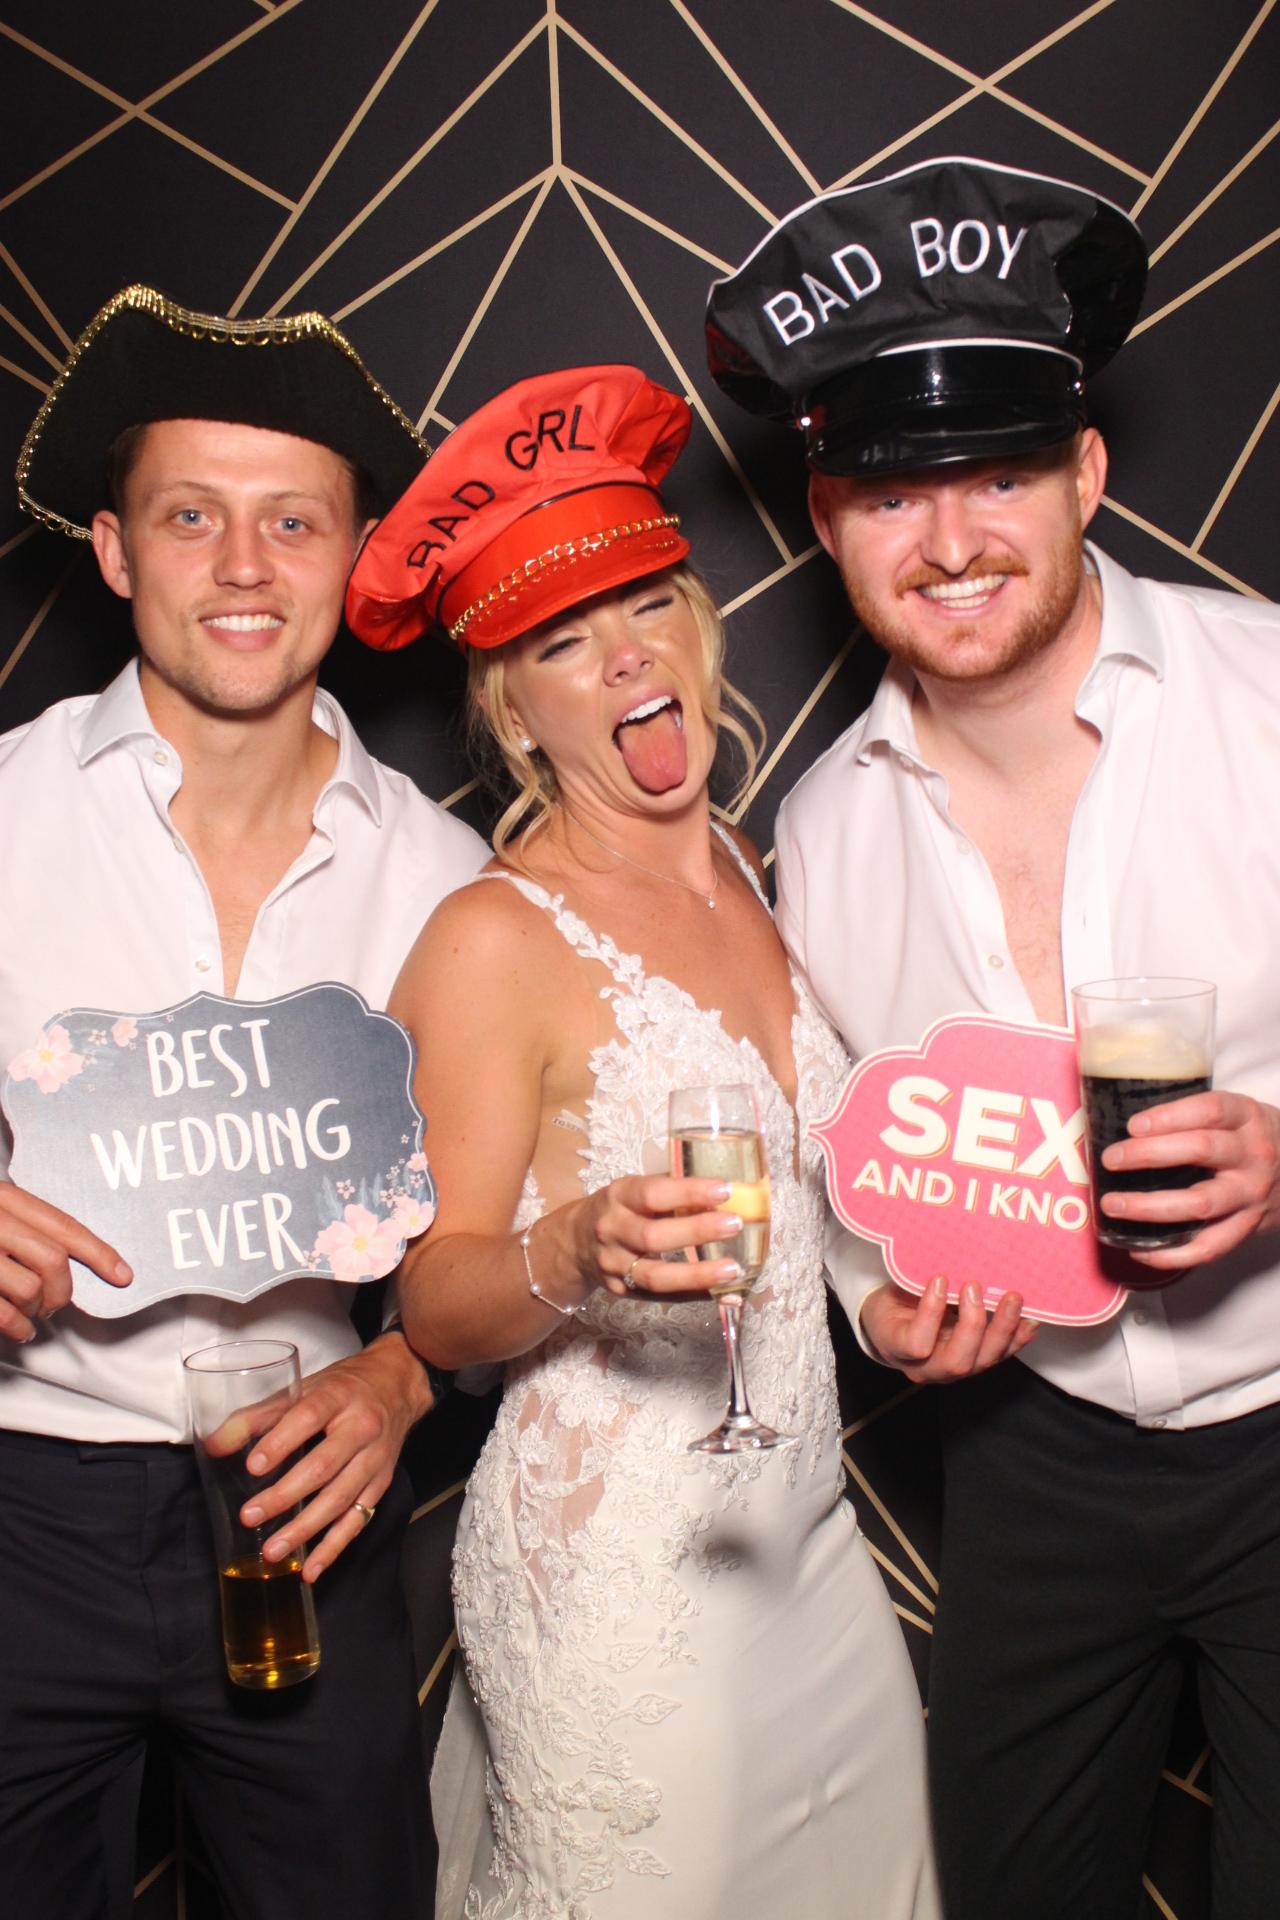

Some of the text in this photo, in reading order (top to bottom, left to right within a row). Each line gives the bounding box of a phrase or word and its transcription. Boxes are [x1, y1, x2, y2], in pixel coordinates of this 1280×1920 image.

[763, 217, 1027, 346] BAD BOY
[406, 480, 496, 569] BAD
[146, 1018, 271, 1098] BEST
[90, 1098, 352, 1190] WEDDING
[879, 1075, 1090, 1186] SEX
[167, 1193, 304, 1271] EVER
[852, 1159, 1091, 1231] AND I KNO
